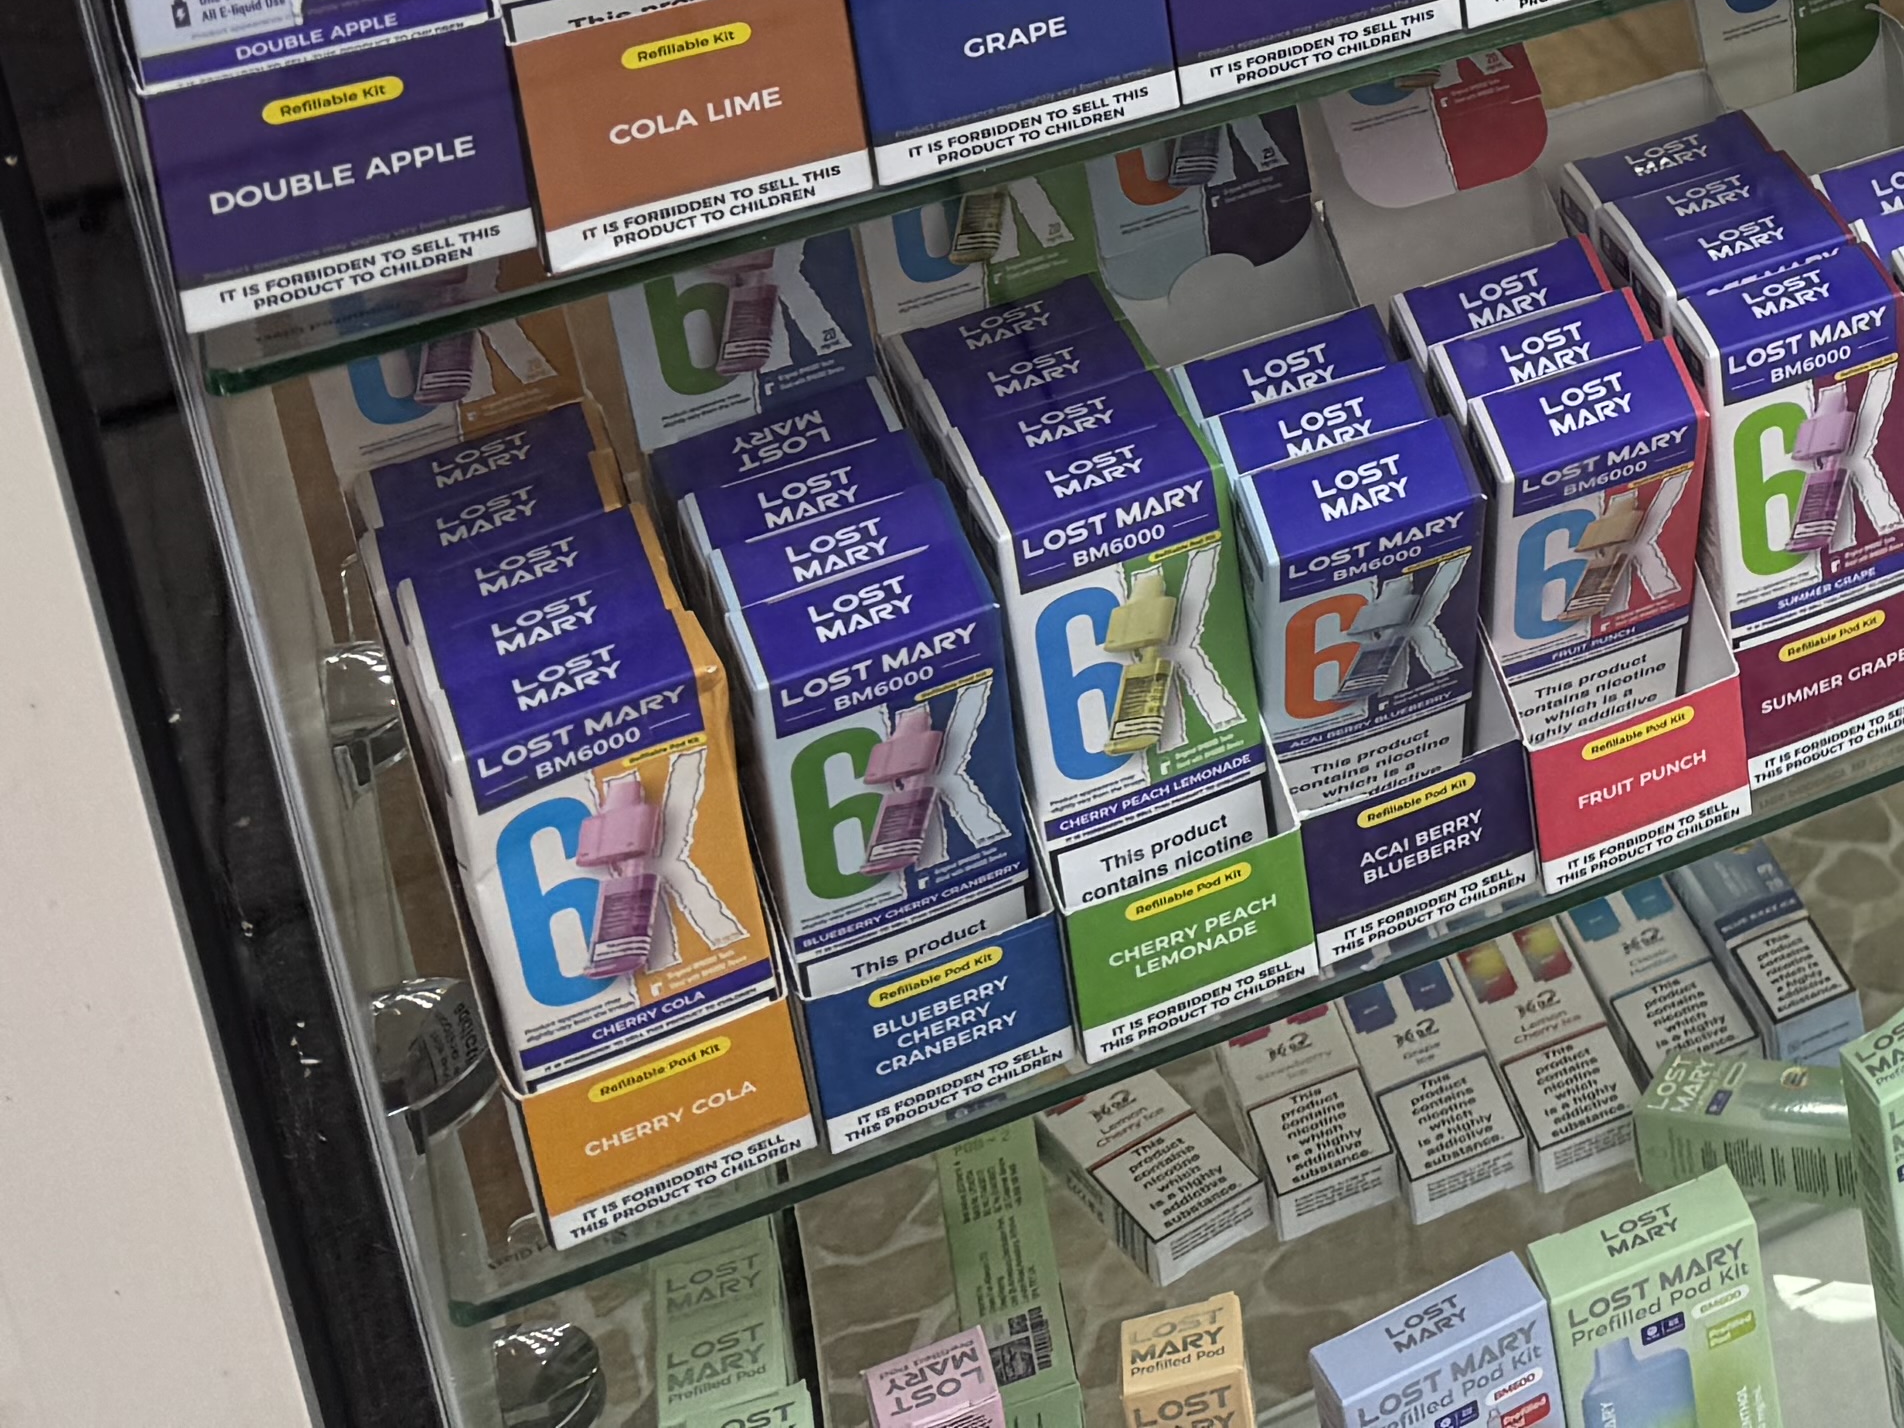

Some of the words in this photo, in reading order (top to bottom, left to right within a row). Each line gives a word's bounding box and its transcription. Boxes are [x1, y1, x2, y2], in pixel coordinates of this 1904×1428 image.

[964, 17, 1066, 57] GRAPE
[280, 91, 358, 117] Refillable
[363, 84, 386, 99] Kit
[610, 109, 698, 144] COLA
[707, 87, 782, 121] LIME
[210, 164, 354, 214] DOUBLE
[366, 136, 475, 179] APPLE
[220, 290, 237, 303] IT
[243, 283, 260, 297] IS
[266, 254, 376, 291] FORBIDDEN
[381, 248, 406, 266] TO
[412, 236, 455, 255] SELL
[459, 224, 500, 245] THIS
[254, 280, 345, 310] PRODUCT
[352, 271, 374, 286] TO
[380, 246, 473, 278] CHILDREN
[1762, 675, 1842, 713] SUMMER
[1579, 778, 1633, 809] FRUIT
[1640, 750, 1706, 786] PUNCH
[585, 1108, 683, 1156] CHERRY
[692, 1081, 756, 1114] COLA
[1568, 1277, 1650, 1329] LOST
[1659, 1238, 1743, 1289] MARY
[1571, 1296, 1661, 1346] Prefilled
[1670, 1276, 1712, 1307] Pod
[1720, 1263, 1748, 1285] Kit
